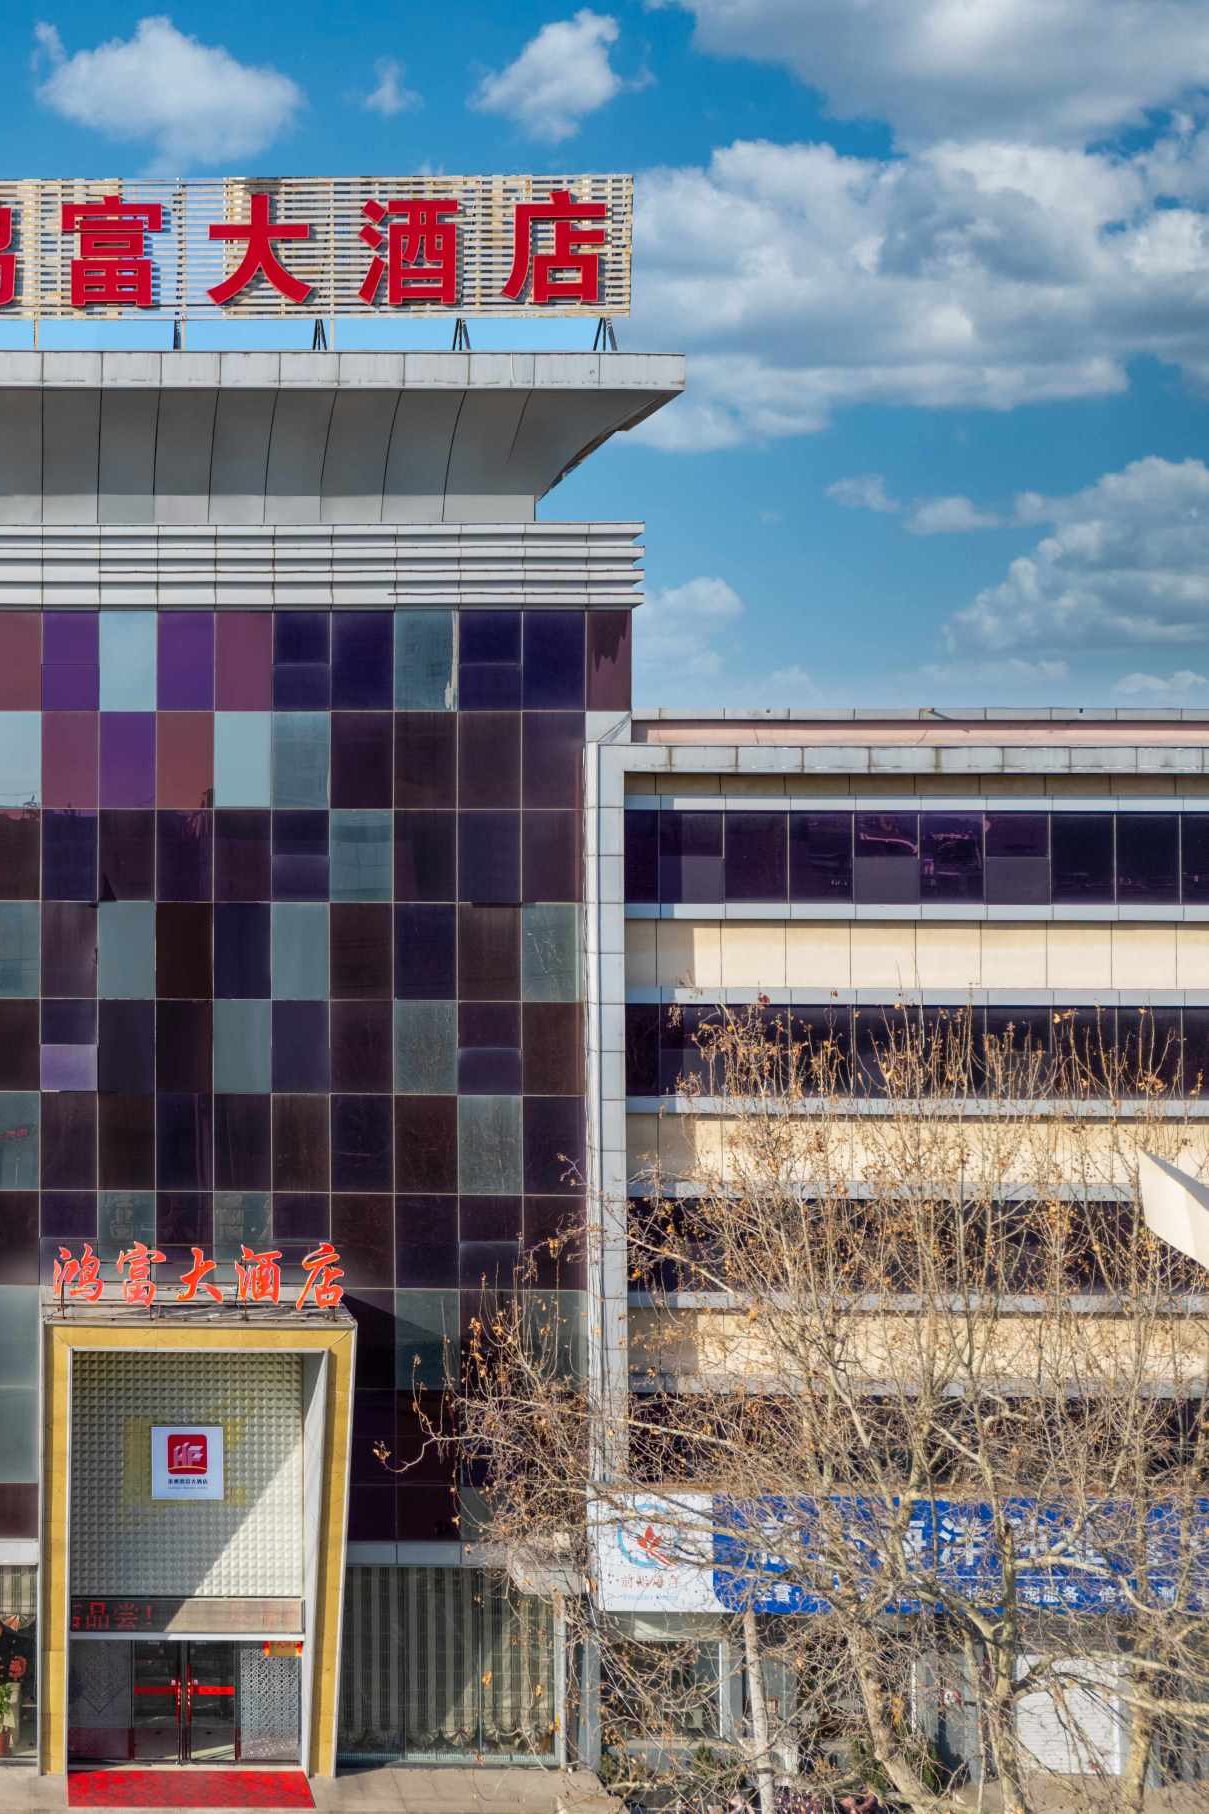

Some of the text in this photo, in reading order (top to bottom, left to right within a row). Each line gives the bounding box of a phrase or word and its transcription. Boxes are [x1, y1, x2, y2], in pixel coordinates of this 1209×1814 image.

[53, 1241, 345, 1310] 鸿富大酒店
